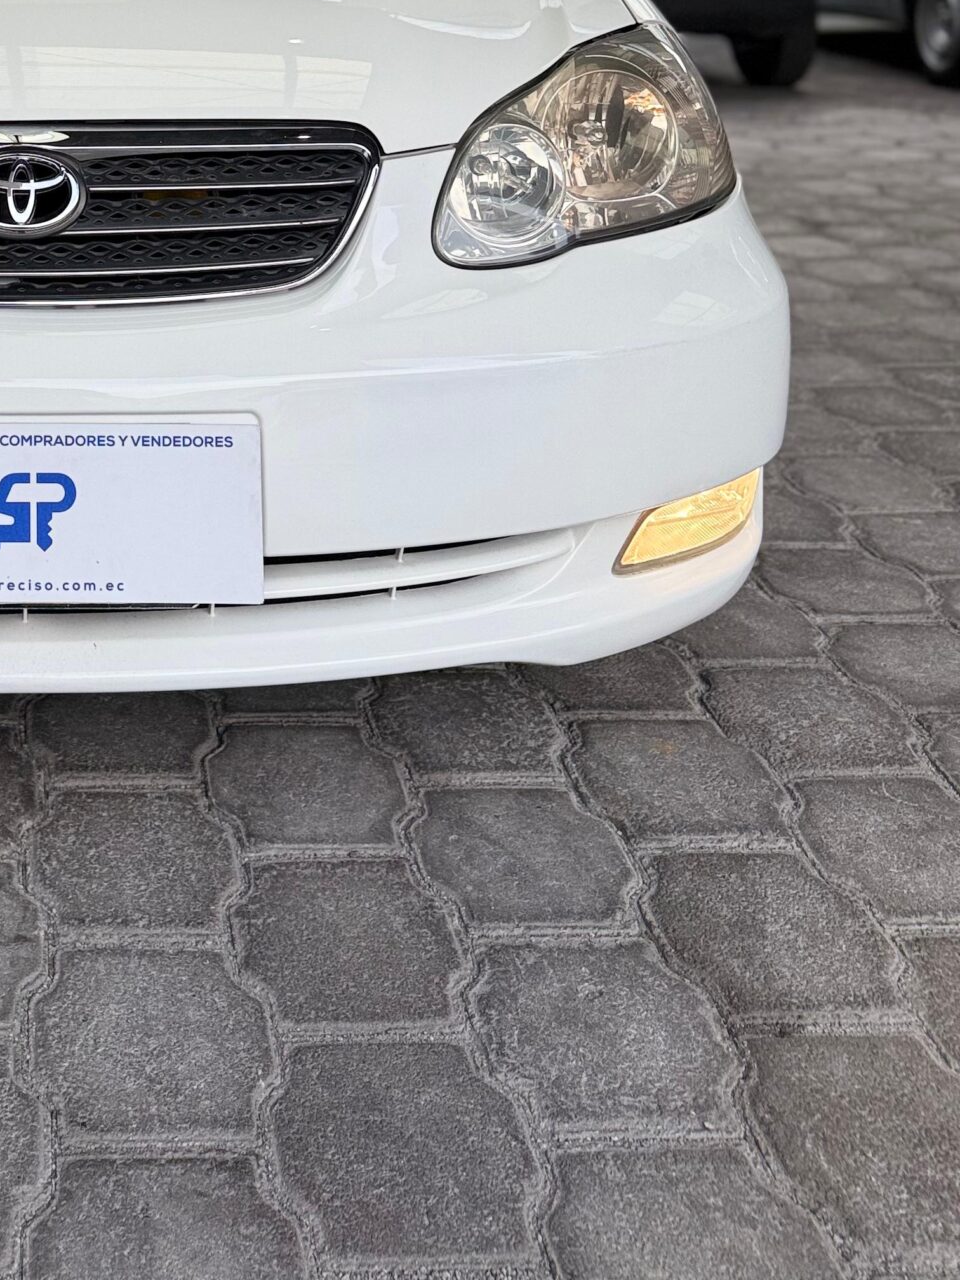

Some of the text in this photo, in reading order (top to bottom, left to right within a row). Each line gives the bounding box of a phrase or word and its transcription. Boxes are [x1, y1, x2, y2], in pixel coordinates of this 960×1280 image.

[0, 434, 116, 448] COMPRADORES
[118, 435, 129, 447] Y
[130, 435, 234, 448] VENDEDORES
